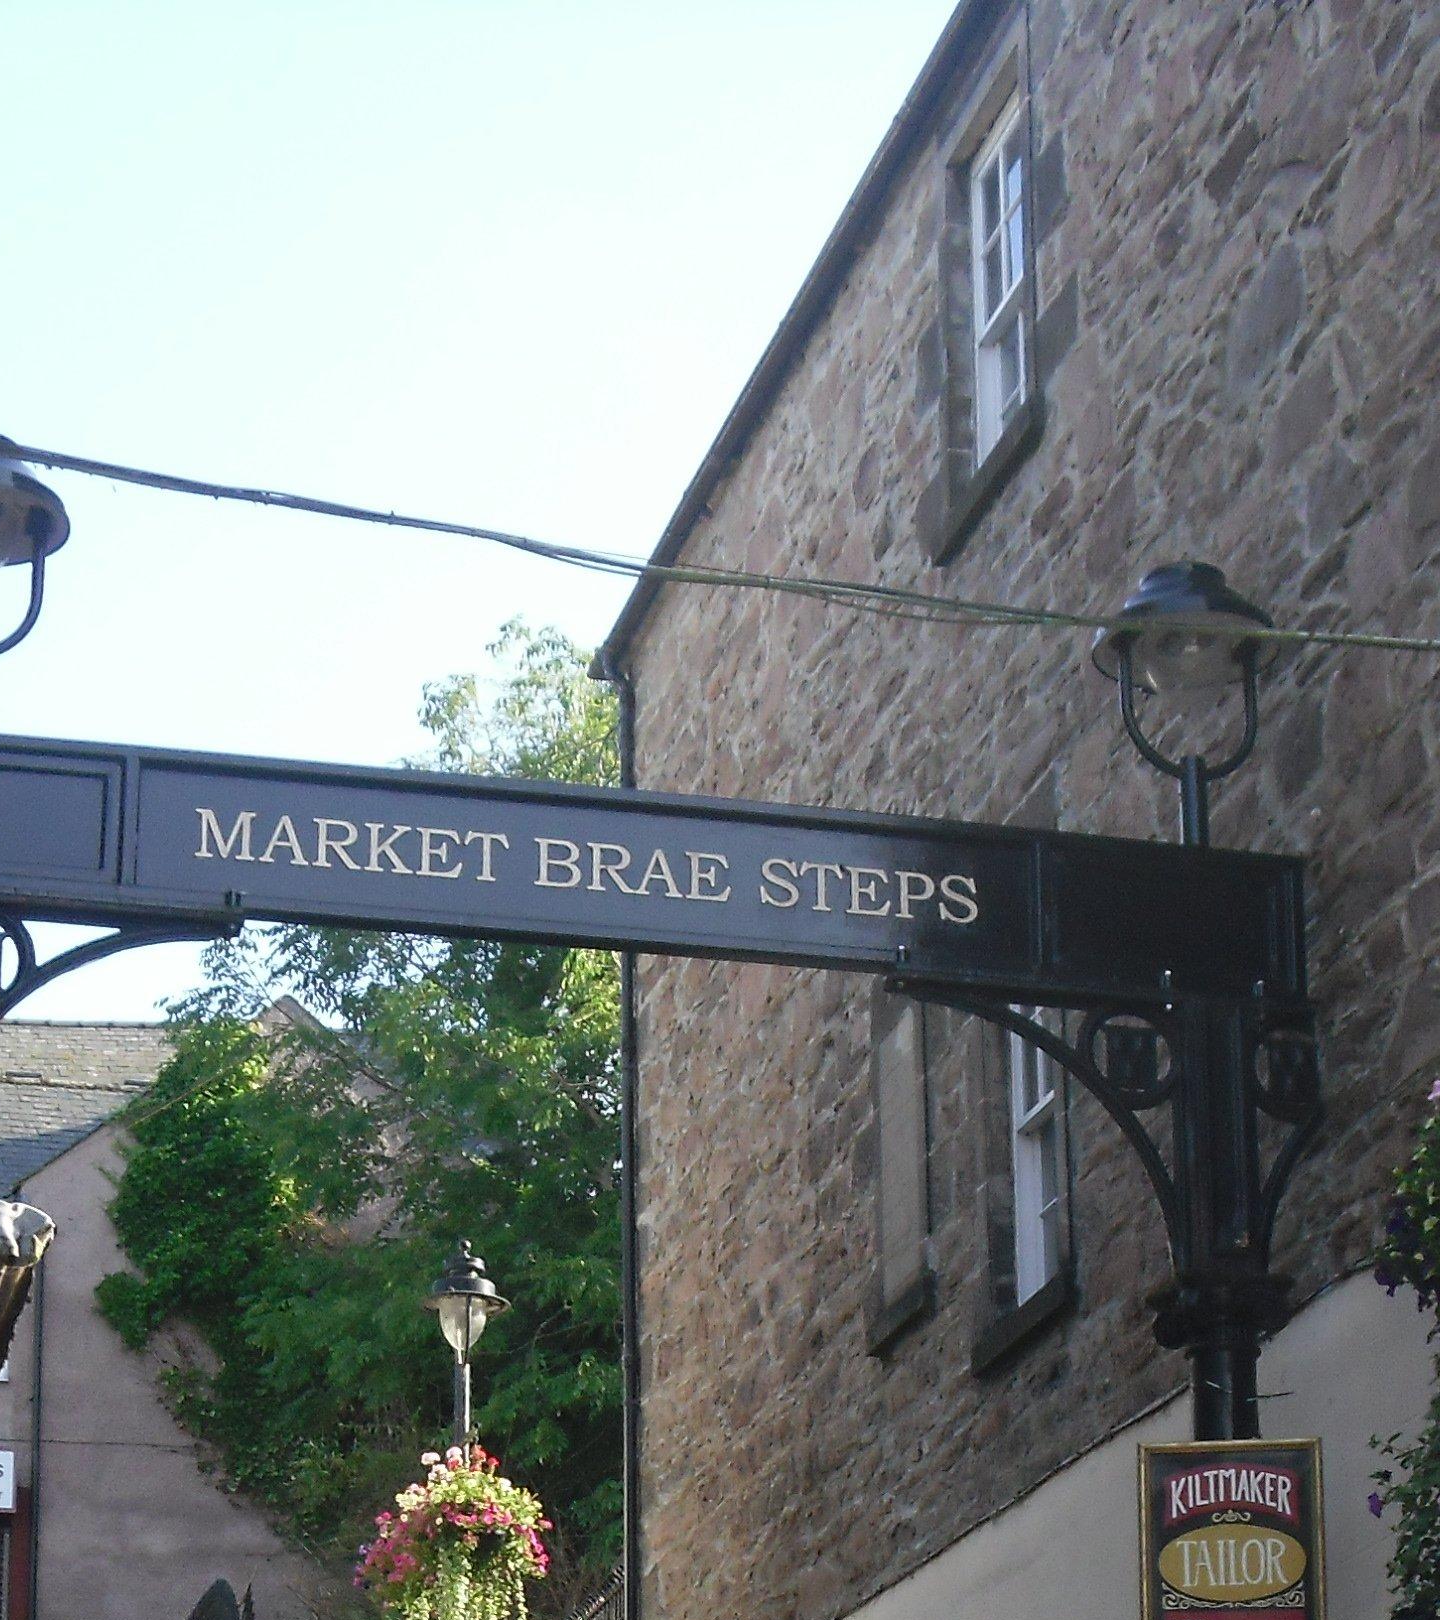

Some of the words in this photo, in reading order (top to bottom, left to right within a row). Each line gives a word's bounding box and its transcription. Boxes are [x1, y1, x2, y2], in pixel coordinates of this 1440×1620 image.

[194, 807, 510, 882] MARKET
[533, 837, 732, 903] BRAE
[759, 857, 980, 925] STEPS
[1170, 1468, 1292, 1519] KILTMAKER
[1176, 1537, 1290, 1589] TAILOR
